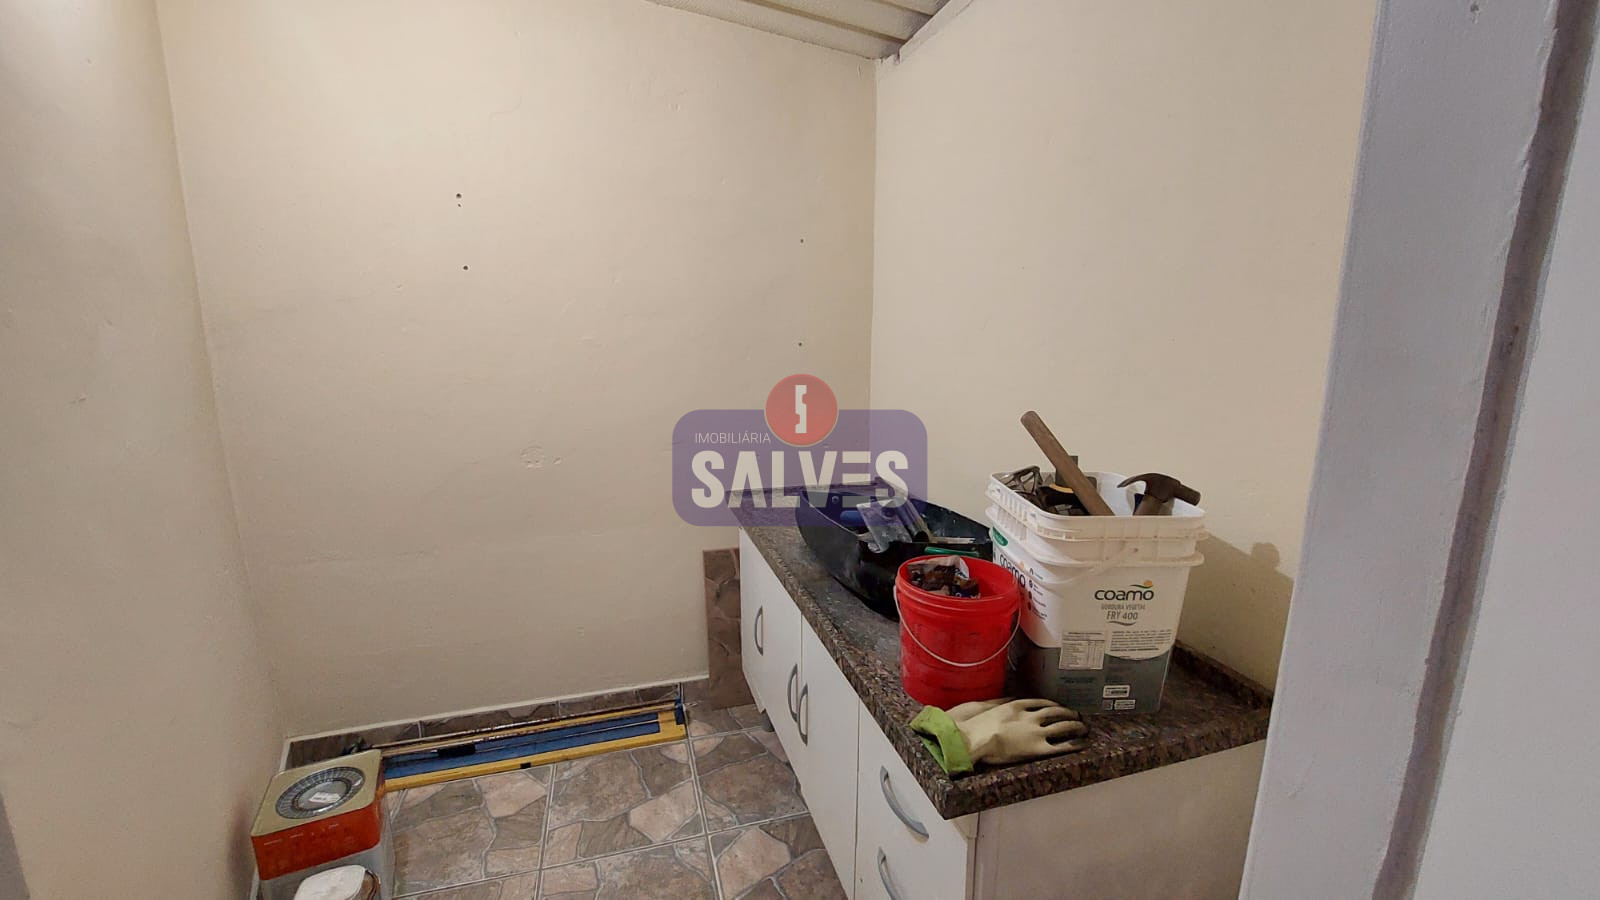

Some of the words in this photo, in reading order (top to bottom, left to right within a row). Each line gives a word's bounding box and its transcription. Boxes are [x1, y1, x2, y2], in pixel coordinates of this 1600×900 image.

[1094, 589, 1155, 601] coamo
[1106, 611, 1122, 620] FRY
[1122, 611, 1139, 620] 400
